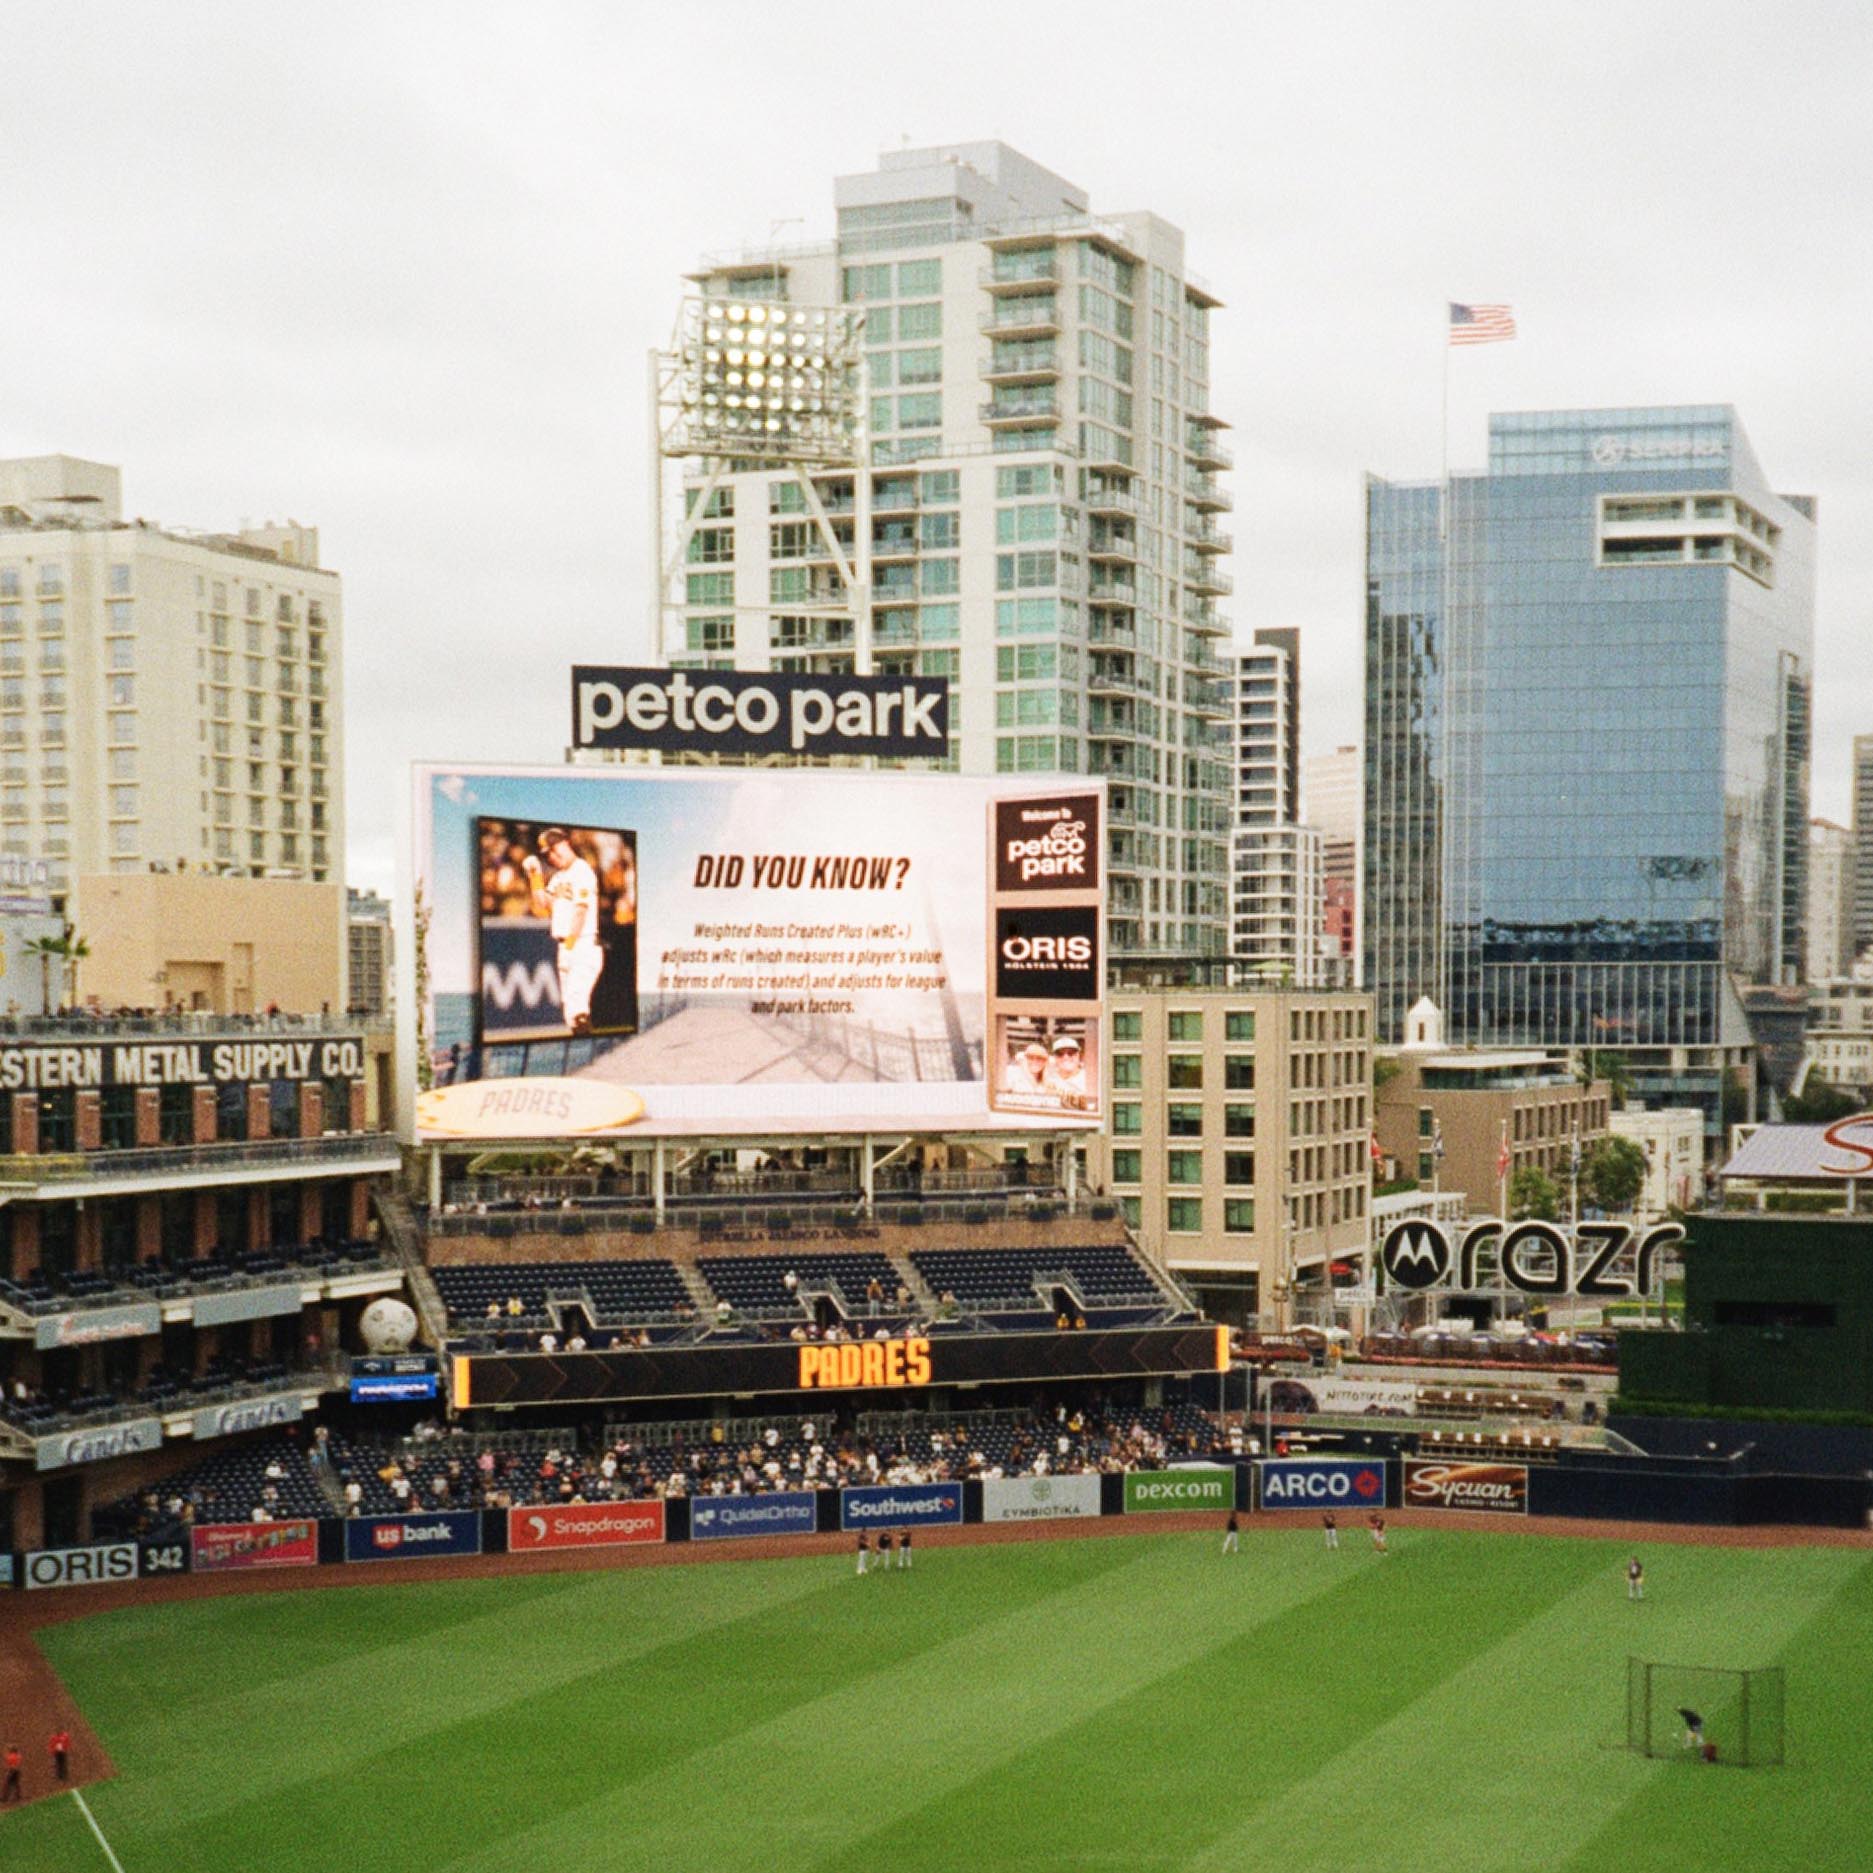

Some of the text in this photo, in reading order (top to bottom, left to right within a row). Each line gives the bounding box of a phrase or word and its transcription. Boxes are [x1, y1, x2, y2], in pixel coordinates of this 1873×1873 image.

[579, 672, 942, 750] petco park
[1008, 835, 1086, 862] petco
[694, 855, 911, 890] DID YOU KNOW?
[1022, 855, 1086, 881] park
[694, 923, 752, 941] Weighted
[754, 923, 785, 938] Runs
[787, 923, 835, 939] Created
[838, 924, 863, 938] Plus
[661, 949, 708, 966] adjusts
[740, 949, 782, 964] (which
[785, 951, 845, 963] measures
[847, 952, 855, 962] a
[856, 949, 906, 966] player's
[908, 950, 943, 963] value
[1003, 936, 1091, 961] ORIS
[672, 974, 709, 988] terms
[711, 974, 725, 988] of
[727, 976, 754, 988] runs
[757, 973, 810, 989] created)
[811, 974, 837, 988] and
[838, 974, 883, 992] adjusts
[885, 974, 903, 988] for
[904, 974, 947, 992] league
[751, 998, 856, 1017] and park factors.
[0, 1042, 364, 1088] STERN METAL SUPPLY CO.
[478, 1087, 572, 1119] PADRES
[1459, 1220, 1686, 1296] razr
[800, 1338, 931, 1388] PADRES
[1265, 1473, 1350, 1497] ARCO
[1411, 1466, 1516, 1506] Sycuan
[720, 1506, 810, 1525] QuidelOrtho
[849, 1499, 942, 1517] Southwest
[403, 1523, 451, 1543] bank
[554, 1518, 654, 1536] Snapdragon
[31, 1547, 132, 1584] ORIS
[146, 1546, 184, 1571] 342
